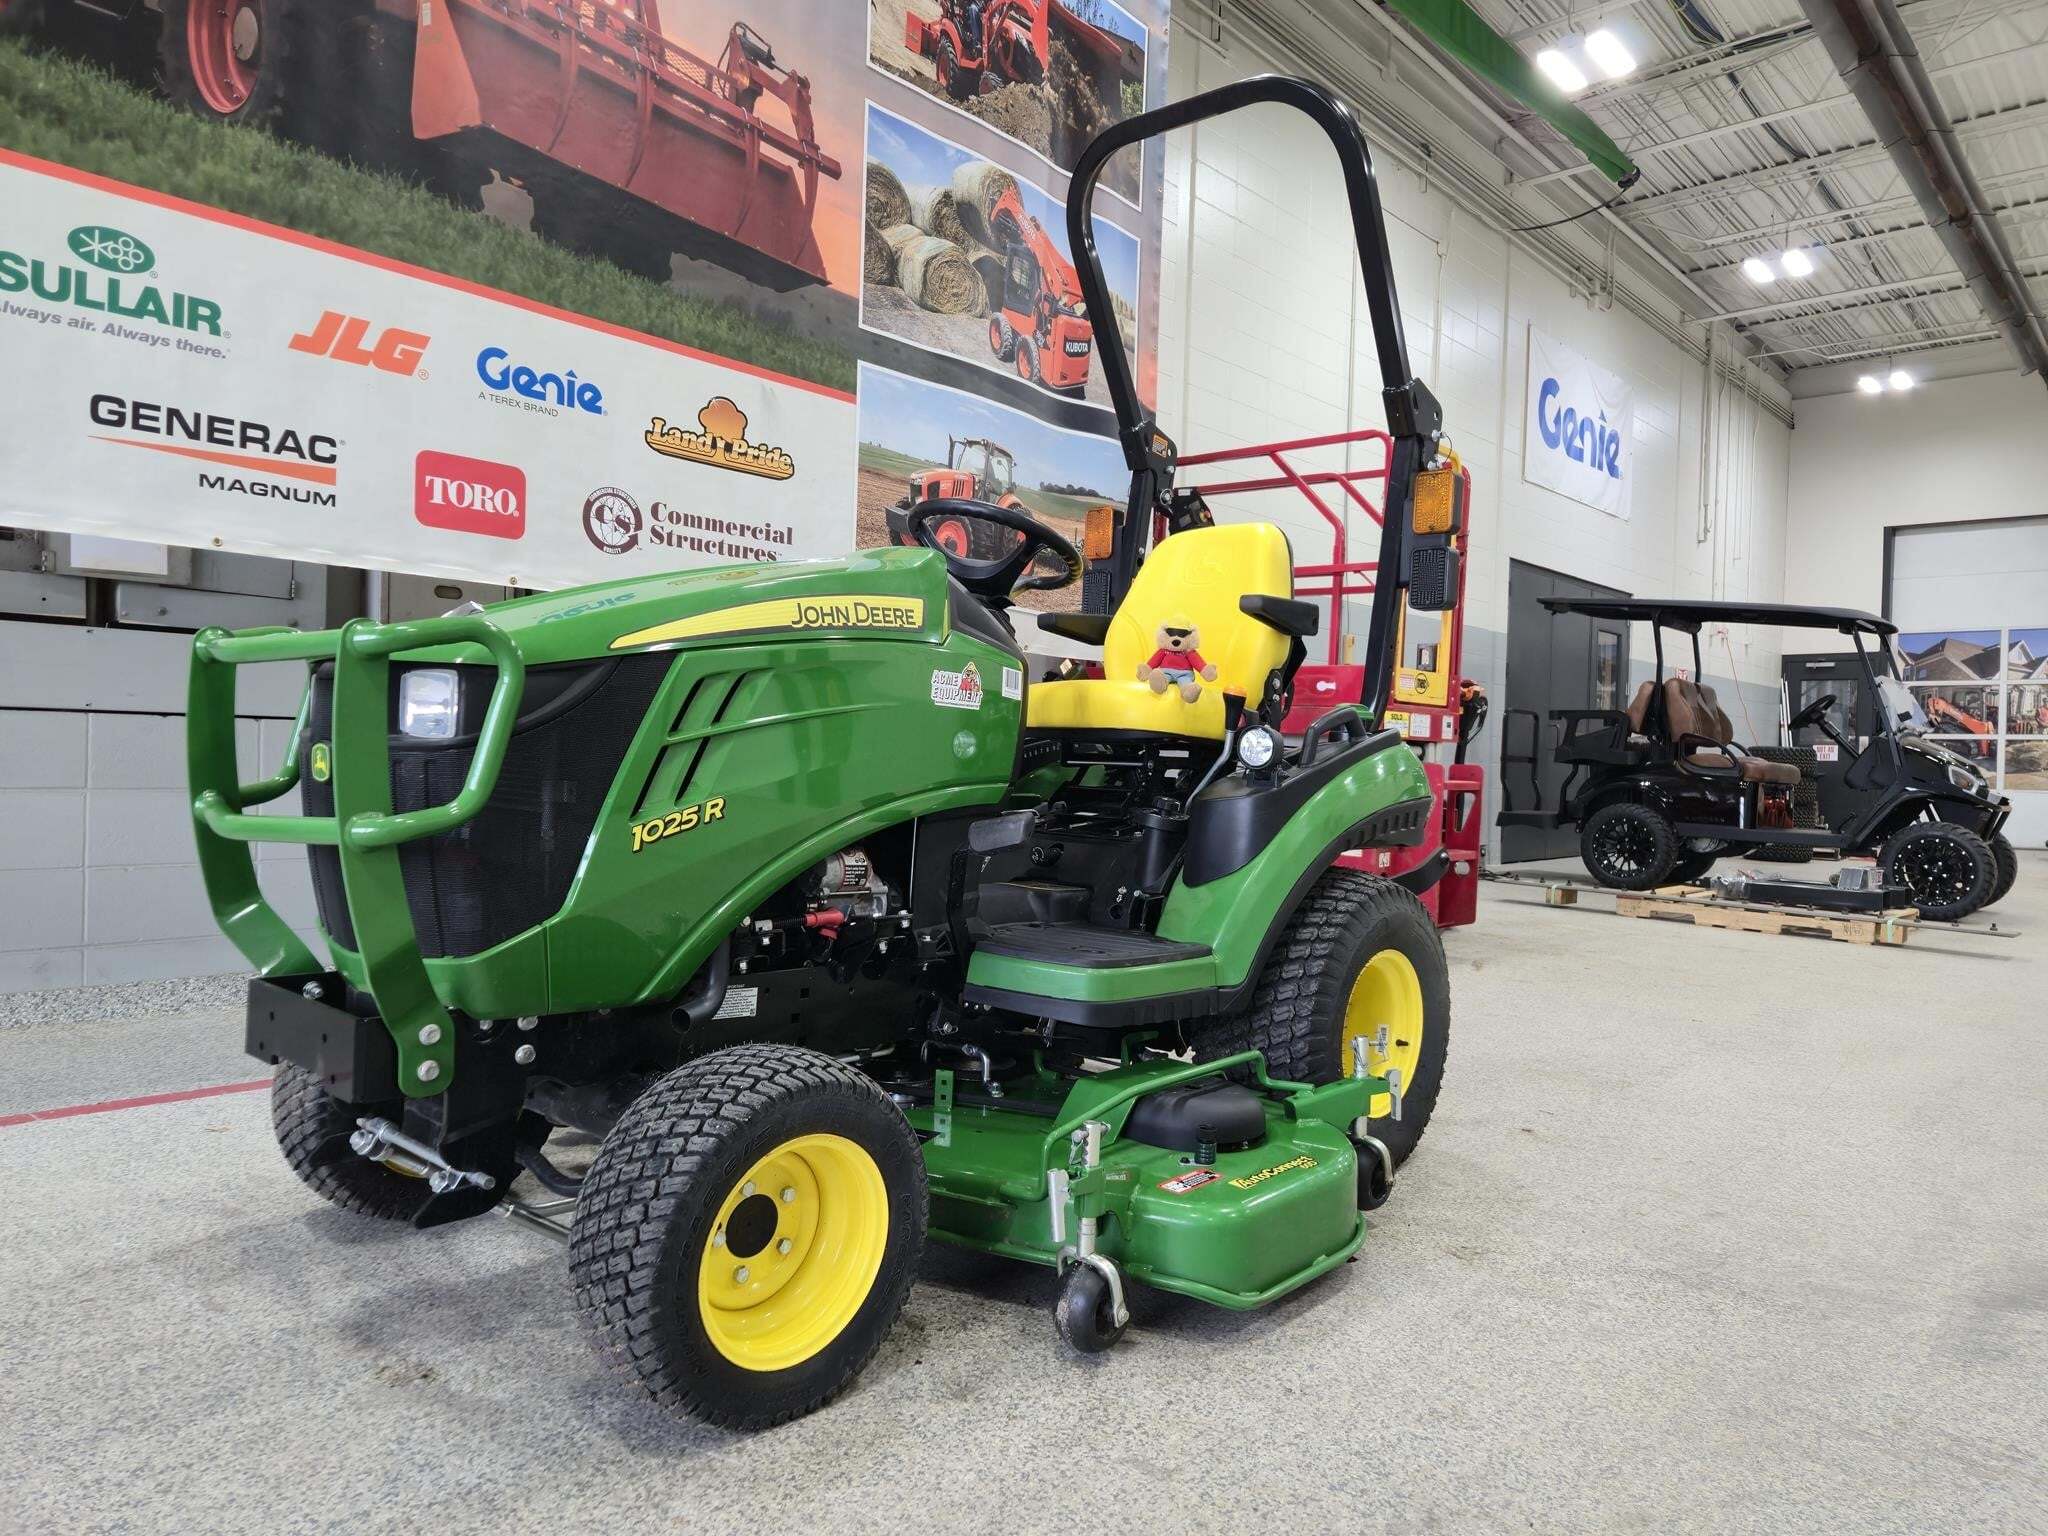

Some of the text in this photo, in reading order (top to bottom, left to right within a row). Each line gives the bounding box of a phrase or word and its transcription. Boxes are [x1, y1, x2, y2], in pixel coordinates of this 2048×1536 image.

[0, 251, 222, 337] SULLAIR
[0, 300, 227, 360] lways air. Always there.
[288, 310, 432, 377] JLG
[1065, 340, 1090, 353] KUBOTA
[476, 346, 603, 415] Genie
[478, 391, 559, 418] A TEREX BRAND
[90, 394, 337, 465] GENERAC
[650, 416, 793, 471] Land Pride
[1538, 377, 1620, 480] Genie
[199, 473, 337, 508] MAGNUM
[424, 475, 518, 516] TORO
[650, 501, 794, 546] Commercial
[650, 525, 778, 562] Structures
[791, 601, 917, 628] JOHN DEERE
[932, 673, 959, 687] ACME
[932, 687, 982, 704] EQUIPMENT
[631, 796, 726, 853] 1025 R
